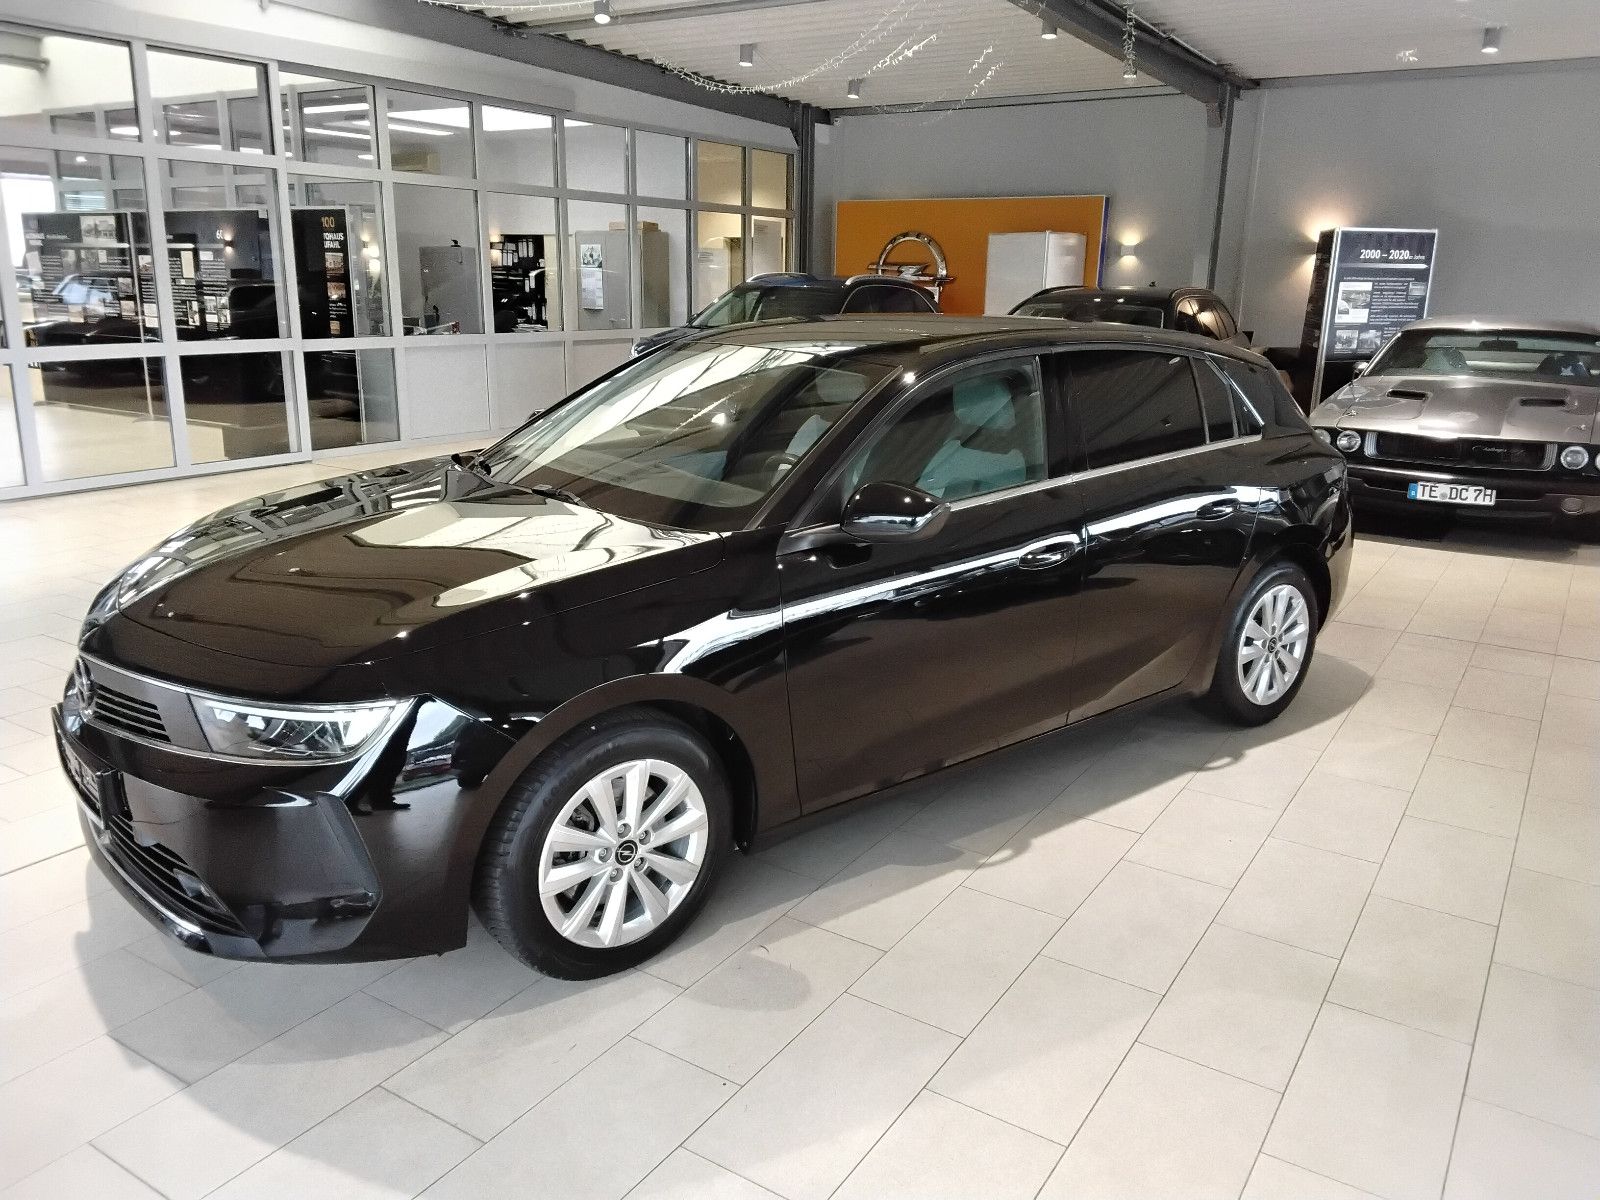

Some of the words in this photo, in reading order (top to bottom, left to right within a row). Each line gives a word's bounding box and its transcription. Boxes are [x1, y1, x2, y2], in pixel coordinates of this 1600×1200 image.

[1360, 249, 1380, 259] 2000
[1420, 483, 1438, 498] TE
[1448, 486, 1469, 501] DC
[1473, 488, 1494, 502] 7H
